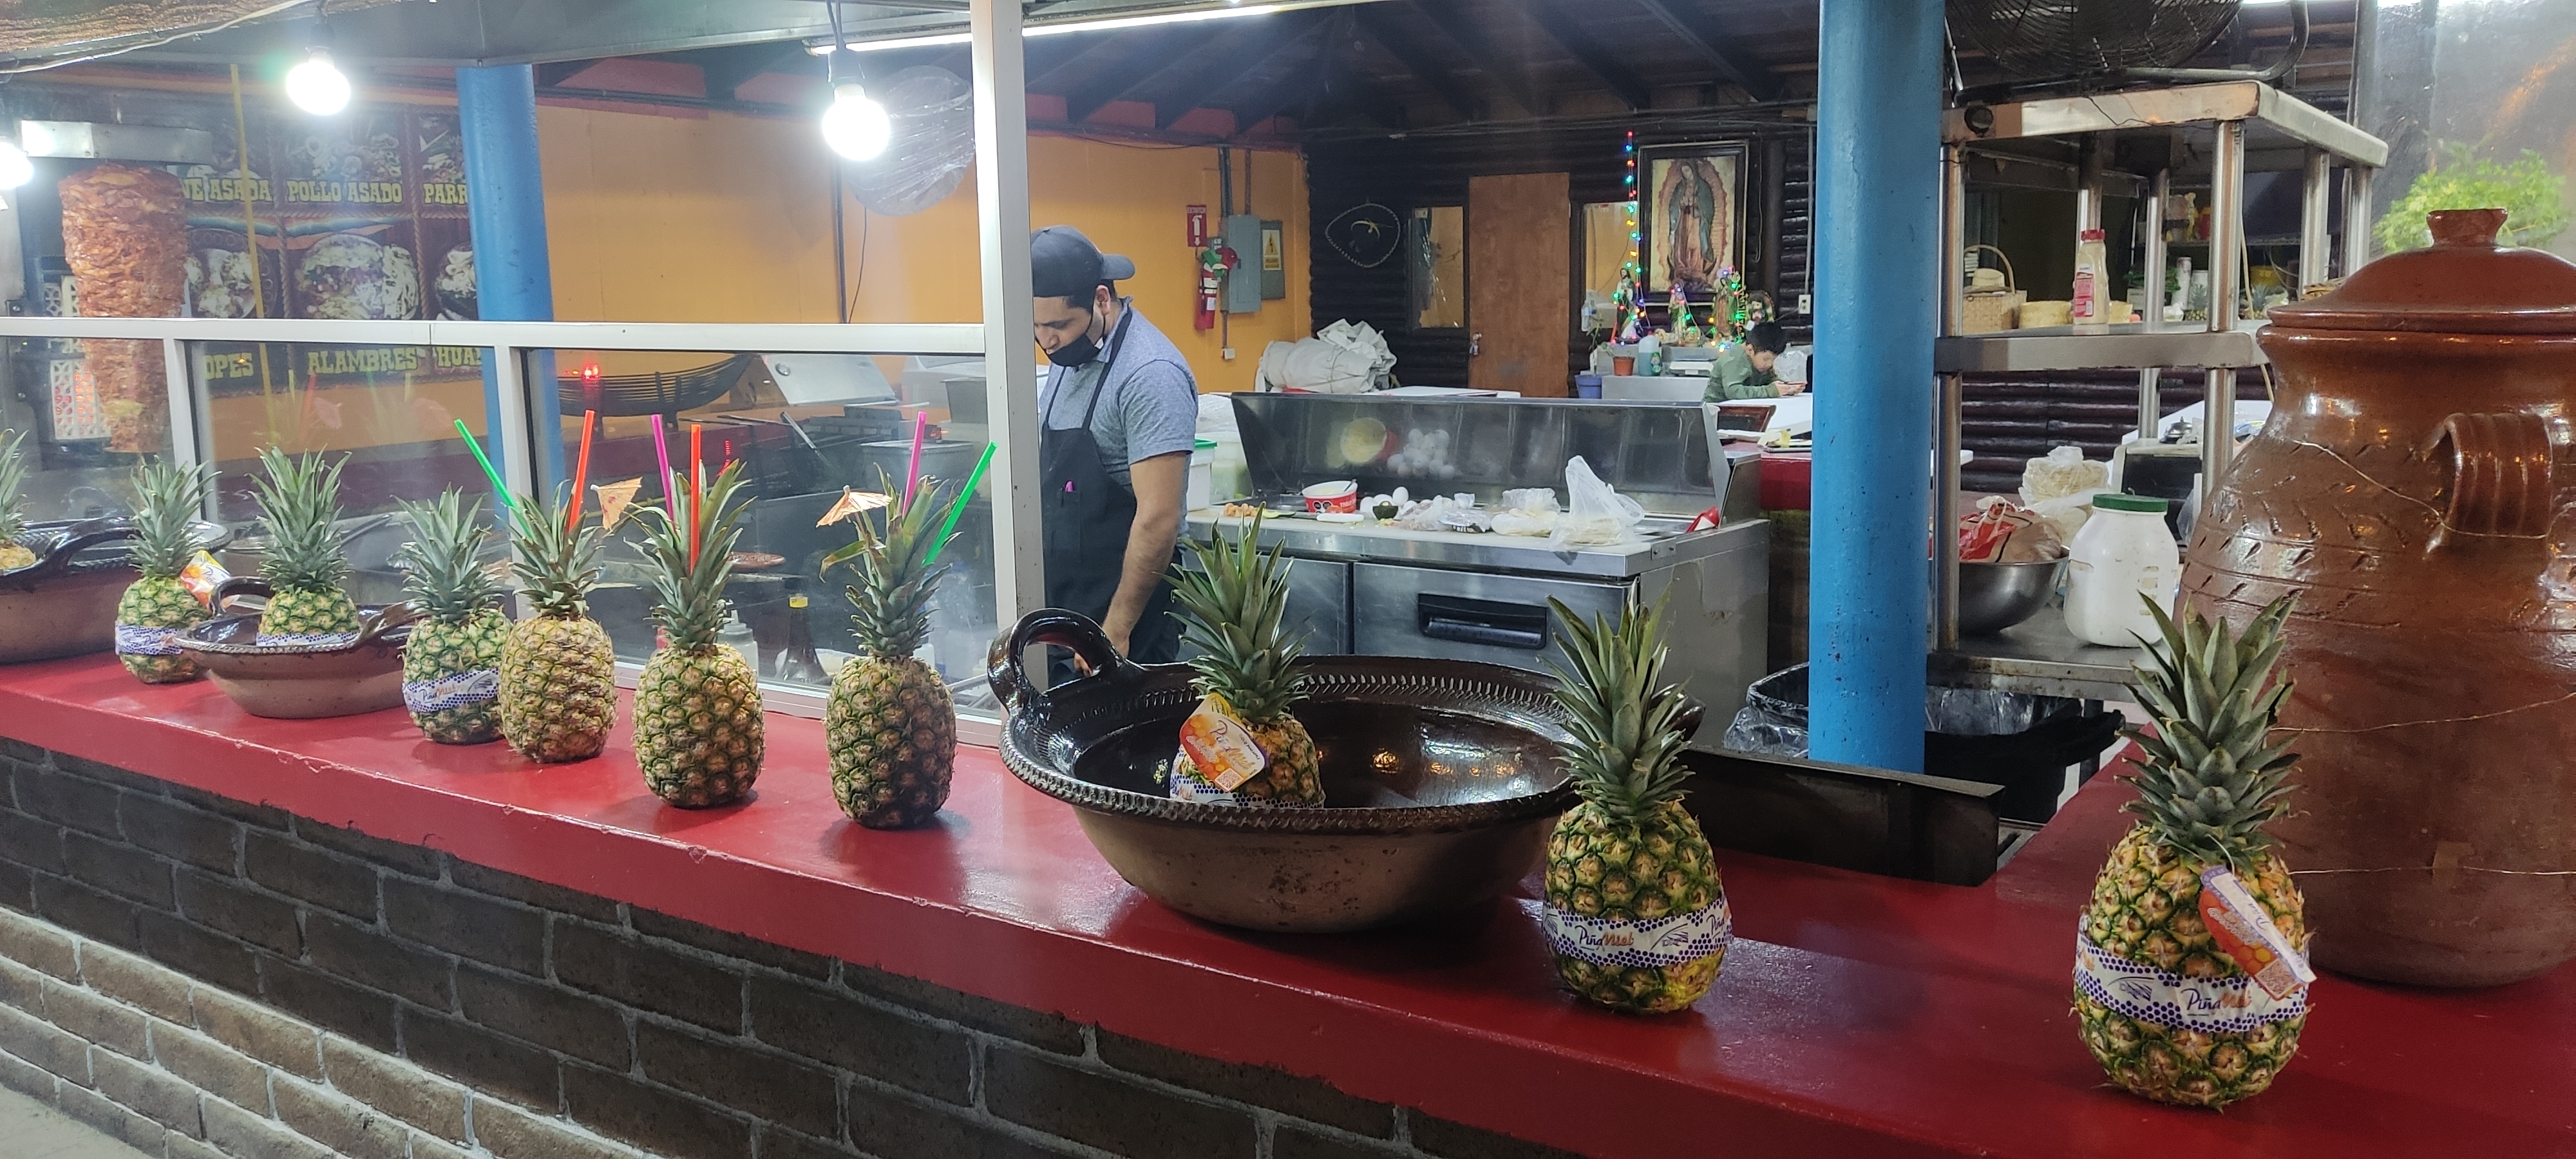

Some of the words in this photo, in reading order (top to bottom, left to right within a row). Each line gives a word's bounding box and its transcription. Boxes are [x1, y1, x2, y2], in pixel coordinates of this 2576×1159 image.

[209, 178, 272, 202] ASADA
[287, 180, 342, 202] POLLO
[347, 181, 402, 203] ASADO
[307, 347, 417, 375] ALAMBRES
